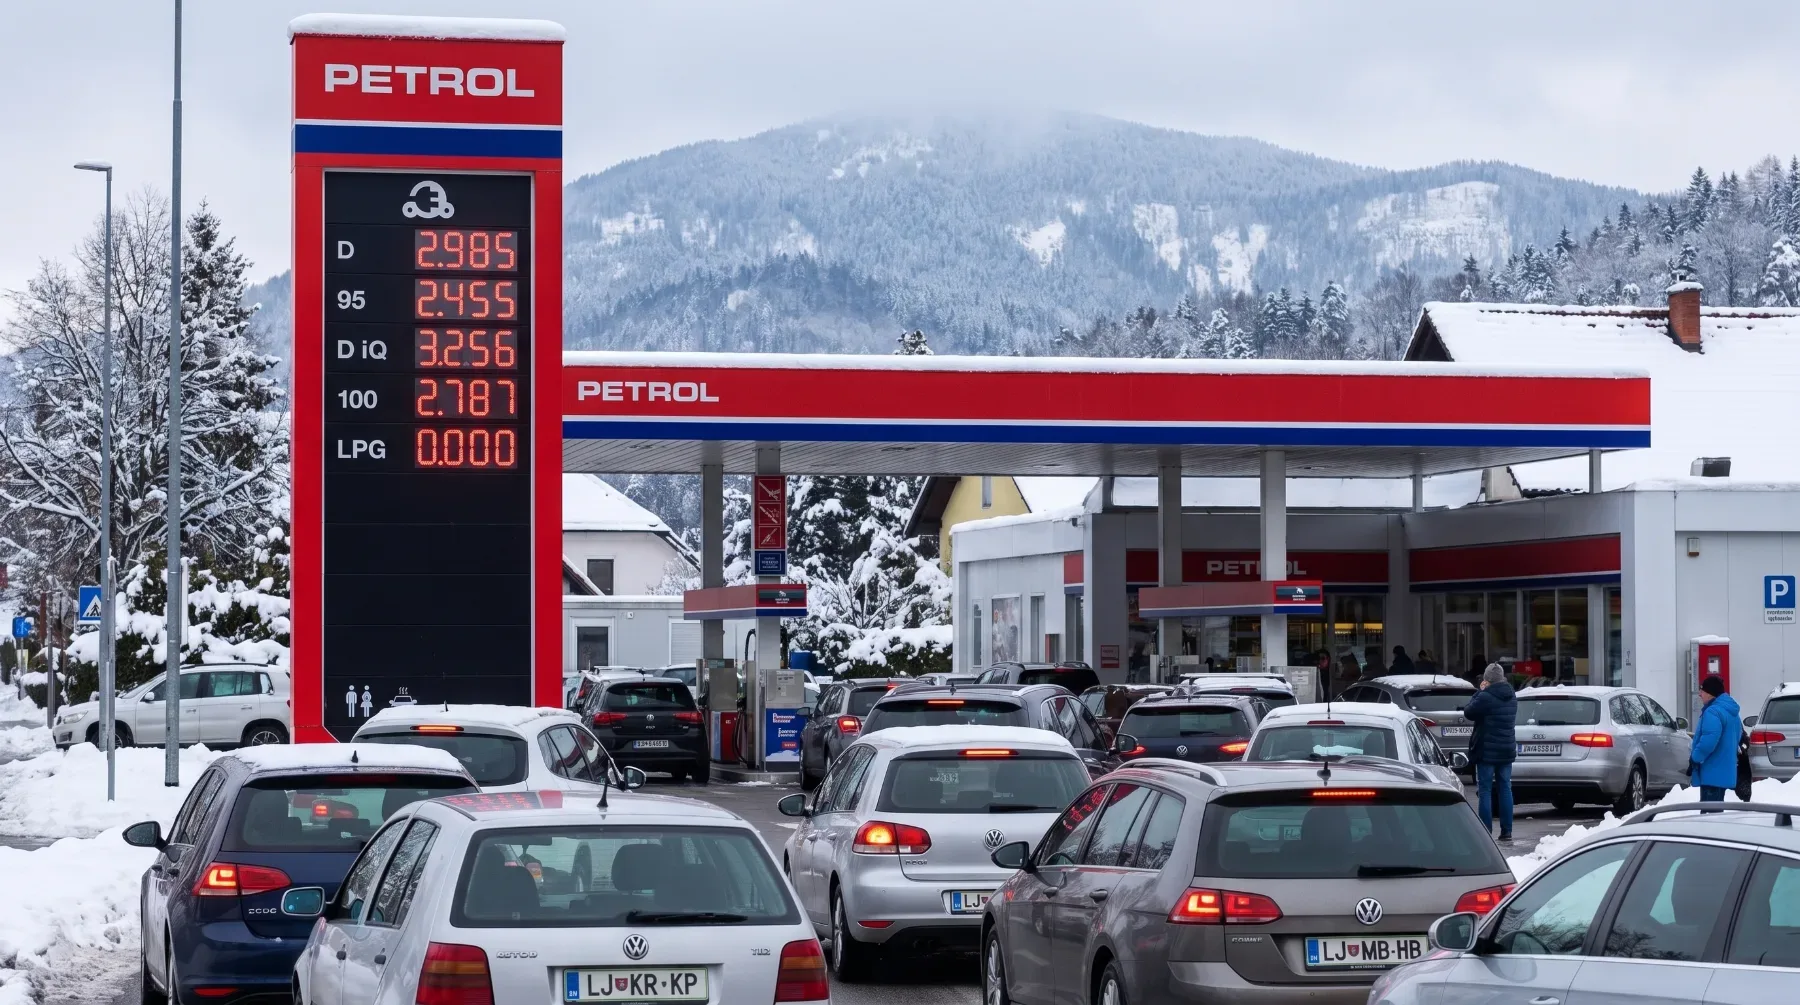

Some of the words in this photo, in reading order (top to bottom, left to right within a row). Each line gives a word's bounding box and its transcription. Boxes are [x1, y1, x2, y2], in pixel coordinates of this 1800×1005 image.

[325, 63, 535, 98] PETROL
[338, 240, 355, 259] D
[418, 231, 515, 269] 2.985
[337, 290, 366, 310] 95
[418, 281, 515, 318] 2.455
[338, 340, 355, 359] D
[362, 340, 388, 361] iQ
[418, 330, 515, 367] 3.256
[338, 390, 378, 409] 100
[417, 379, 515, 417] 2.787
[577, 380, 720, 403] PETROL
[337, 439, 387, 460] LPG
[417, 429, 515, 467] 0.000
[1206, 560, 1307, 576] PETL
[1771, 579, 1789, 605] P
[964, 894, 981, 909] LJ
[1323, 940, 1347, 962] LJ
[1362, 939, 1422, 961] MB-HB
[587, 973, 614, 997] LJ
